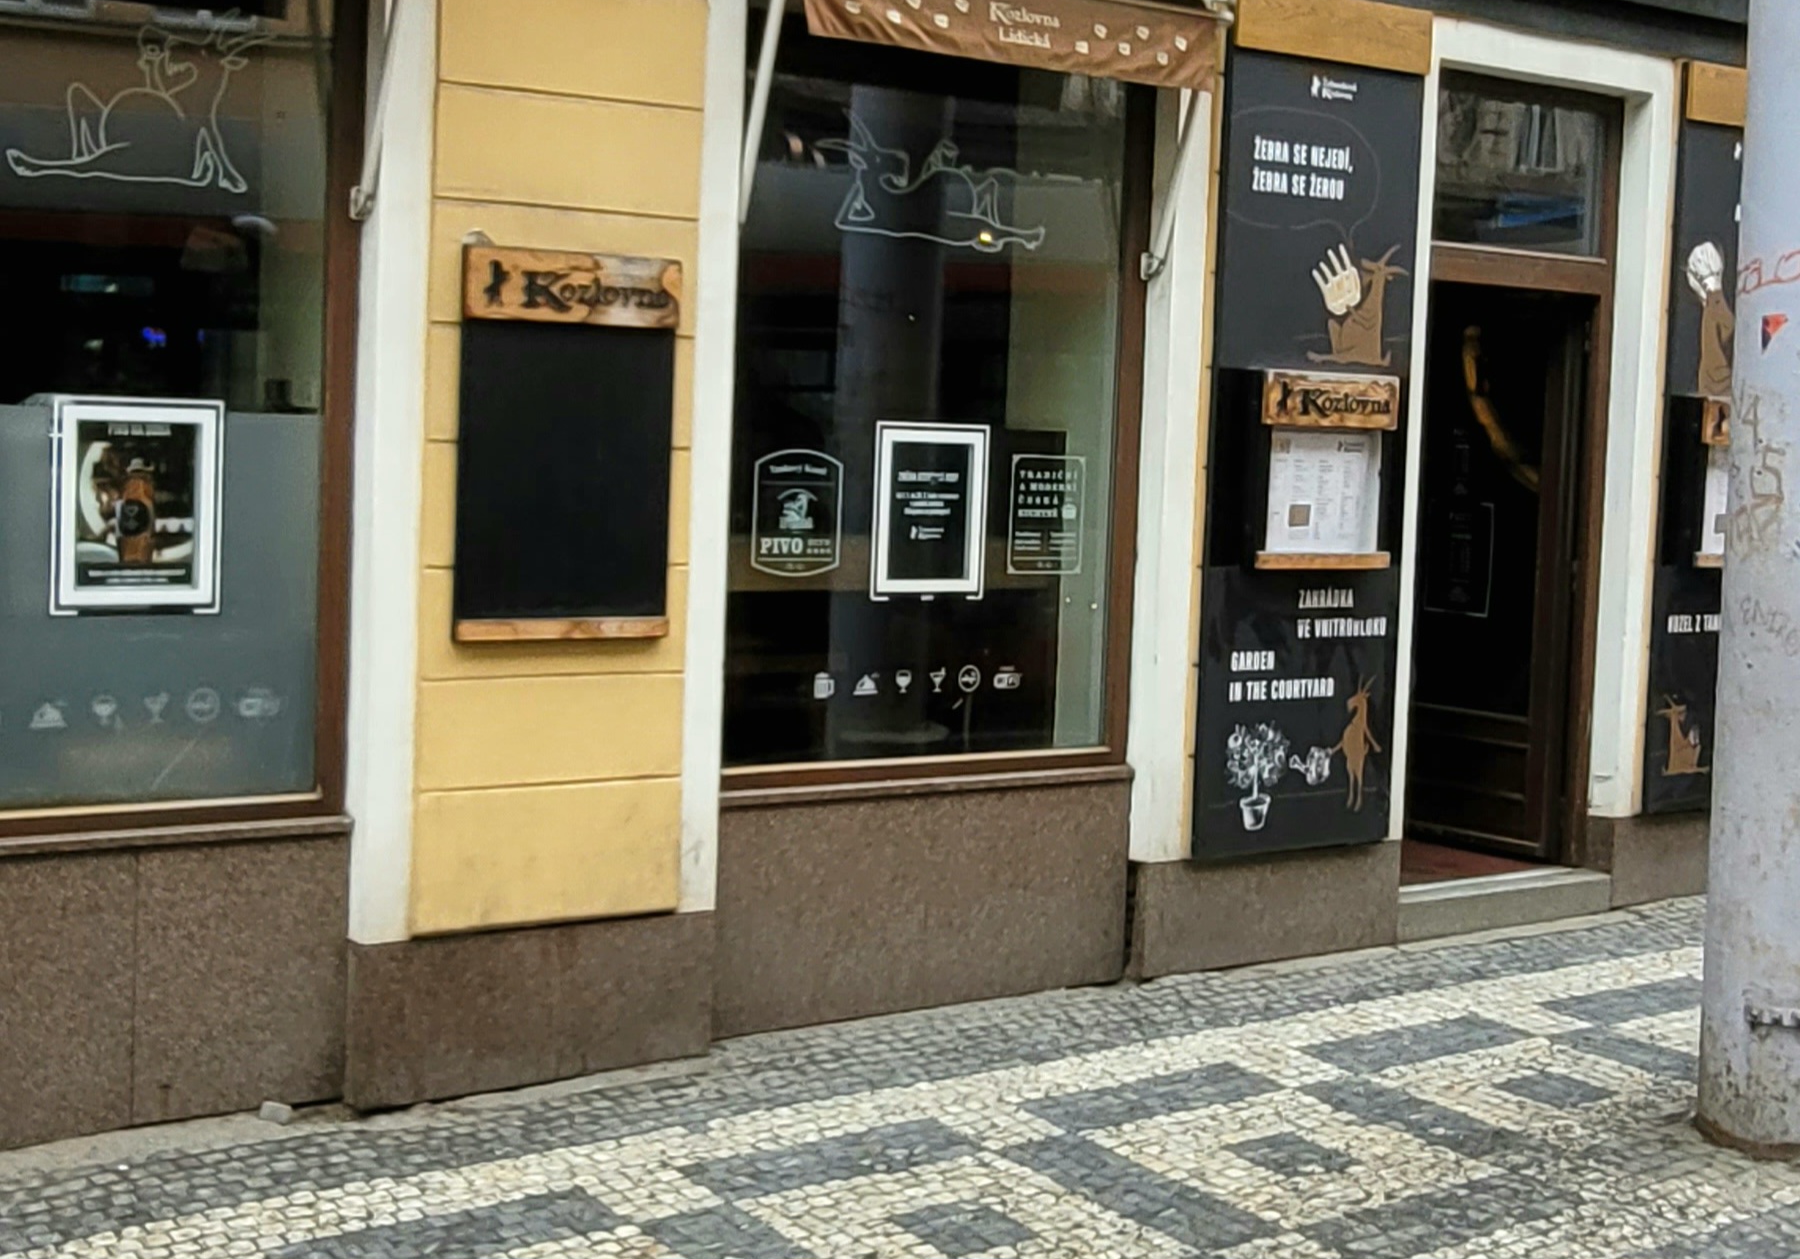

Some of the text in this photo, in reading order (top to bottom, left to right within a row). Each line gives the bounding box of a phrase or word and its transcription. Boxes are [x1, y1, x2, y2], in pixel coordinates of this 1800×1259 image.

[989, 1, 1060, 28] Kozlovna
[998, 26, 1051, 49] Lidická
[1253, 135, 1290, 164] ŽEBRA
[1293, 143, 1308, 166] SE
[1252, 166, 1344, 200] ŽEBRA SE ŽEROU
[520, 270, 670, 313] Kozlovna
[1298, 388, 1391, 418] Kozlovna
[760, 537, 804, 555] PIVO
[1297, 618, 1311, 639] VE
[1230, 650, 1276, 672] GARDEN
[1228, 677, 1335, 703] IN THE COURTYARD
